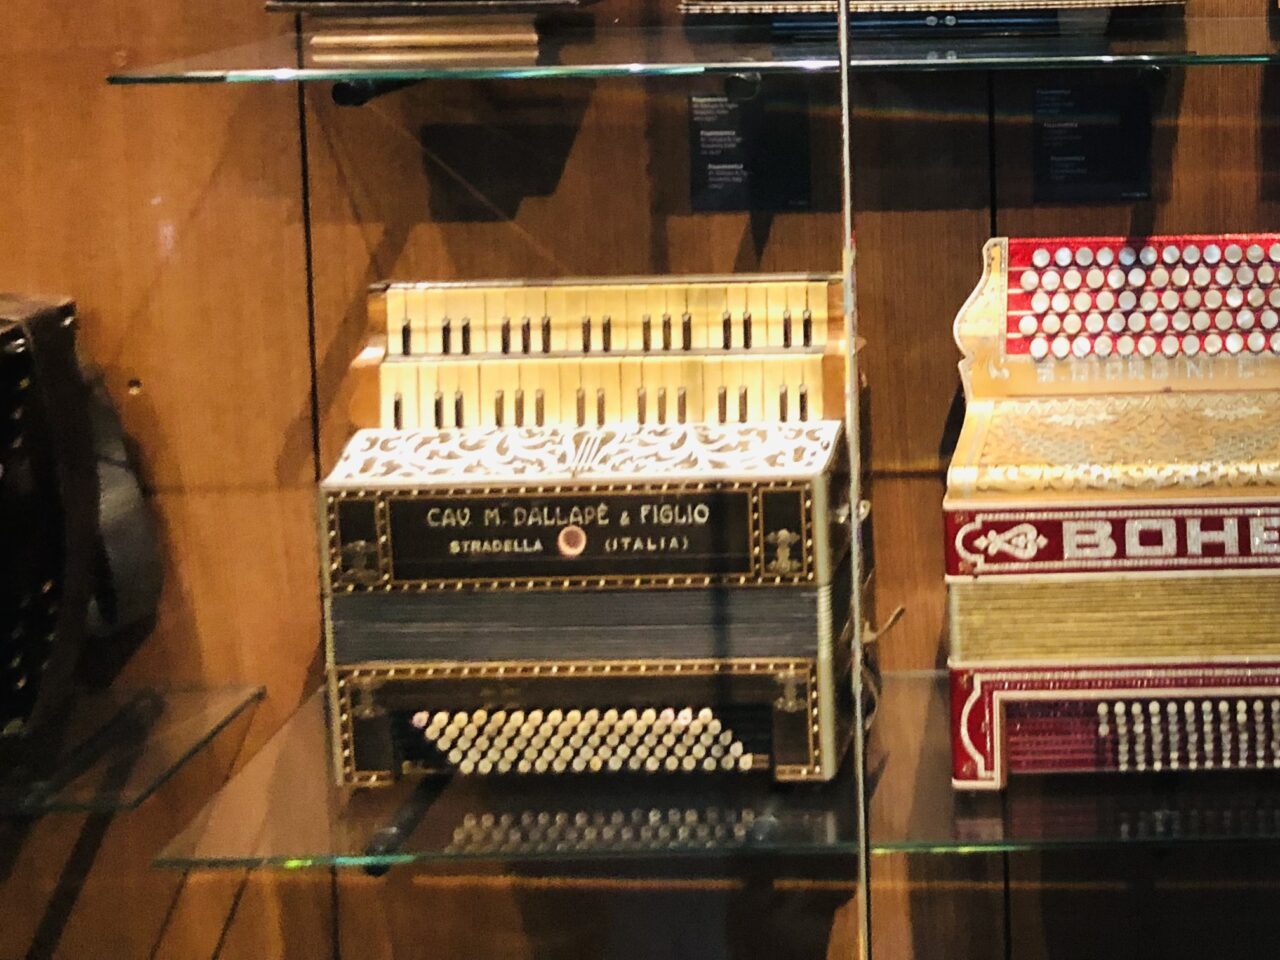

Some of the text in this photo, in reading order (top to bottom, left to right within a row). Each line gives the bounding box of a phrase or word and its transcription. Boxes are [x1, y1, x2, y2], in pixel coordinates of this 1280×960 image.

[620, 510, 631, 526] &
[640, 503, 710, 525] FIGLIO
[449, 535, 689, 554] STRADELLA (ITALIA)
